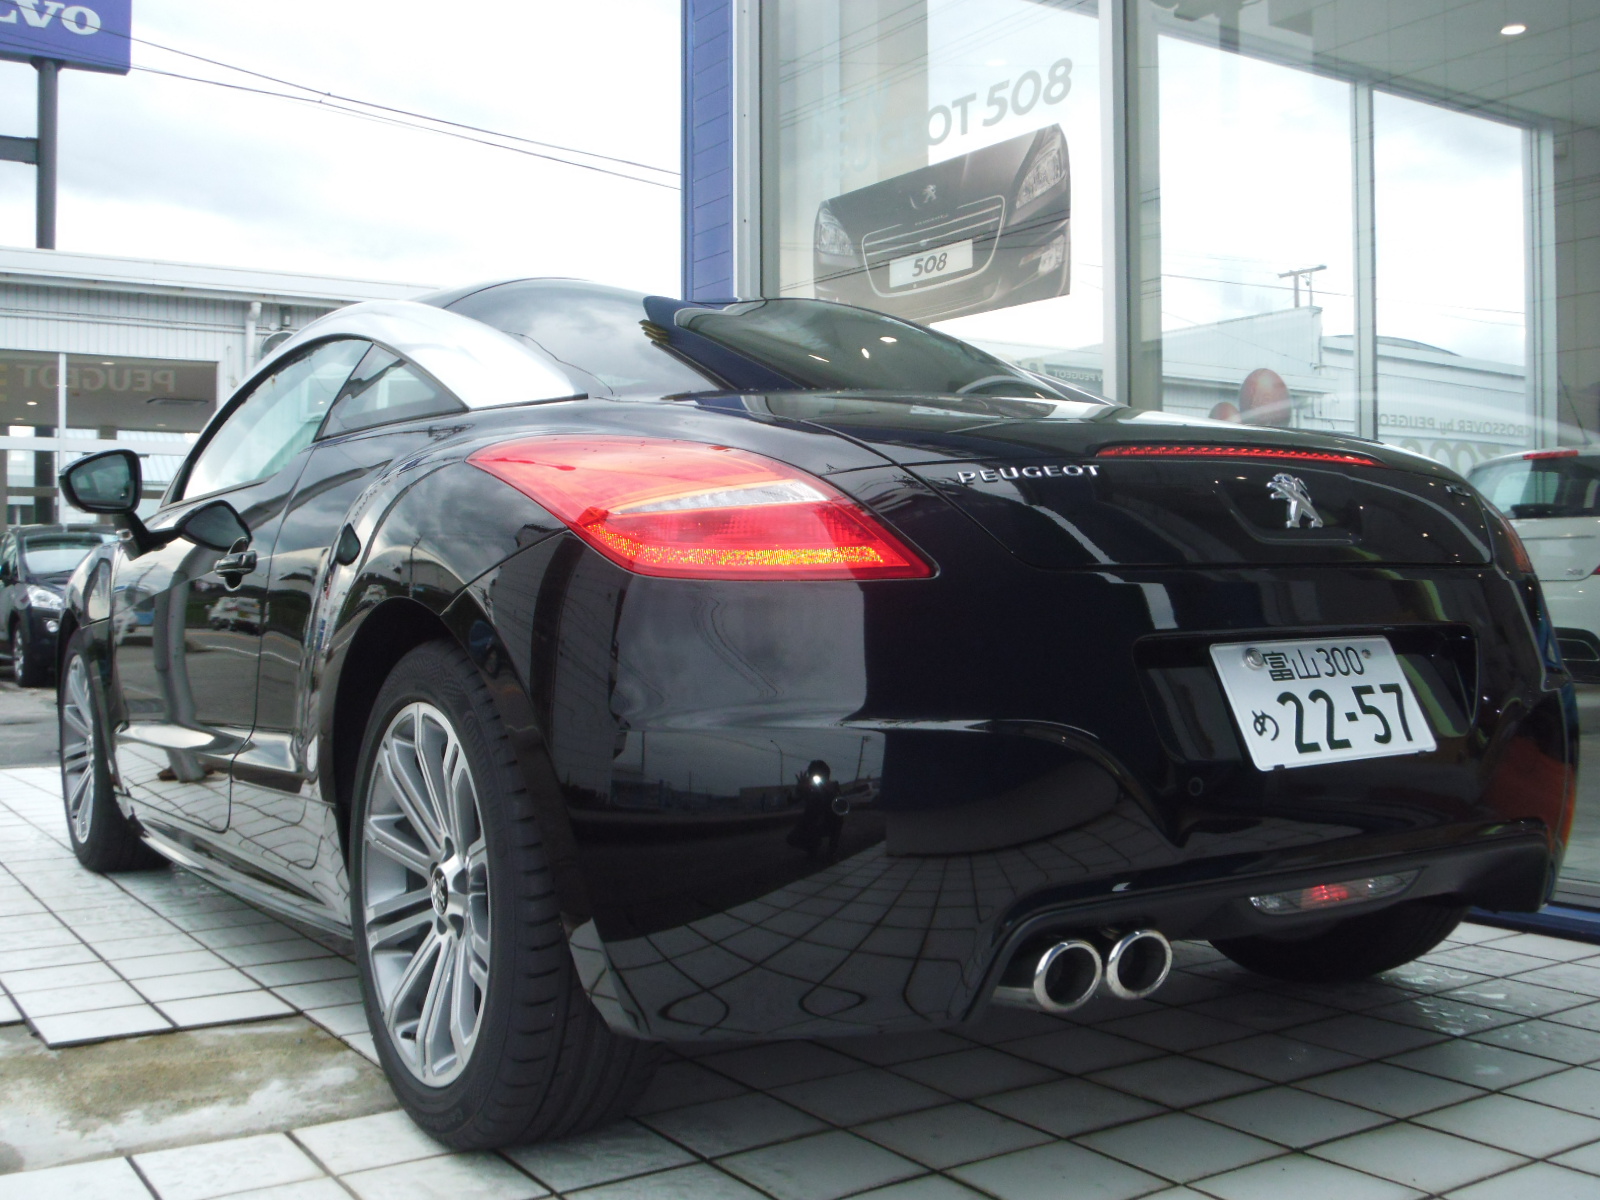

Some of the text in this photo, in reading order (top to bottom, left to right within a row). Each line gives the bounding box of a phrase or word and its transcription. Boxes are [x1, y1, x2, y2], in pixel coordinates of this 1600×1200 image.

[982, 57, 1073, 128] 508
[912, 252, 948, 277] 508
[957, 464, 1100, 484] PEUGEOT
[1251, 682, 1413, 754] め 22-57
